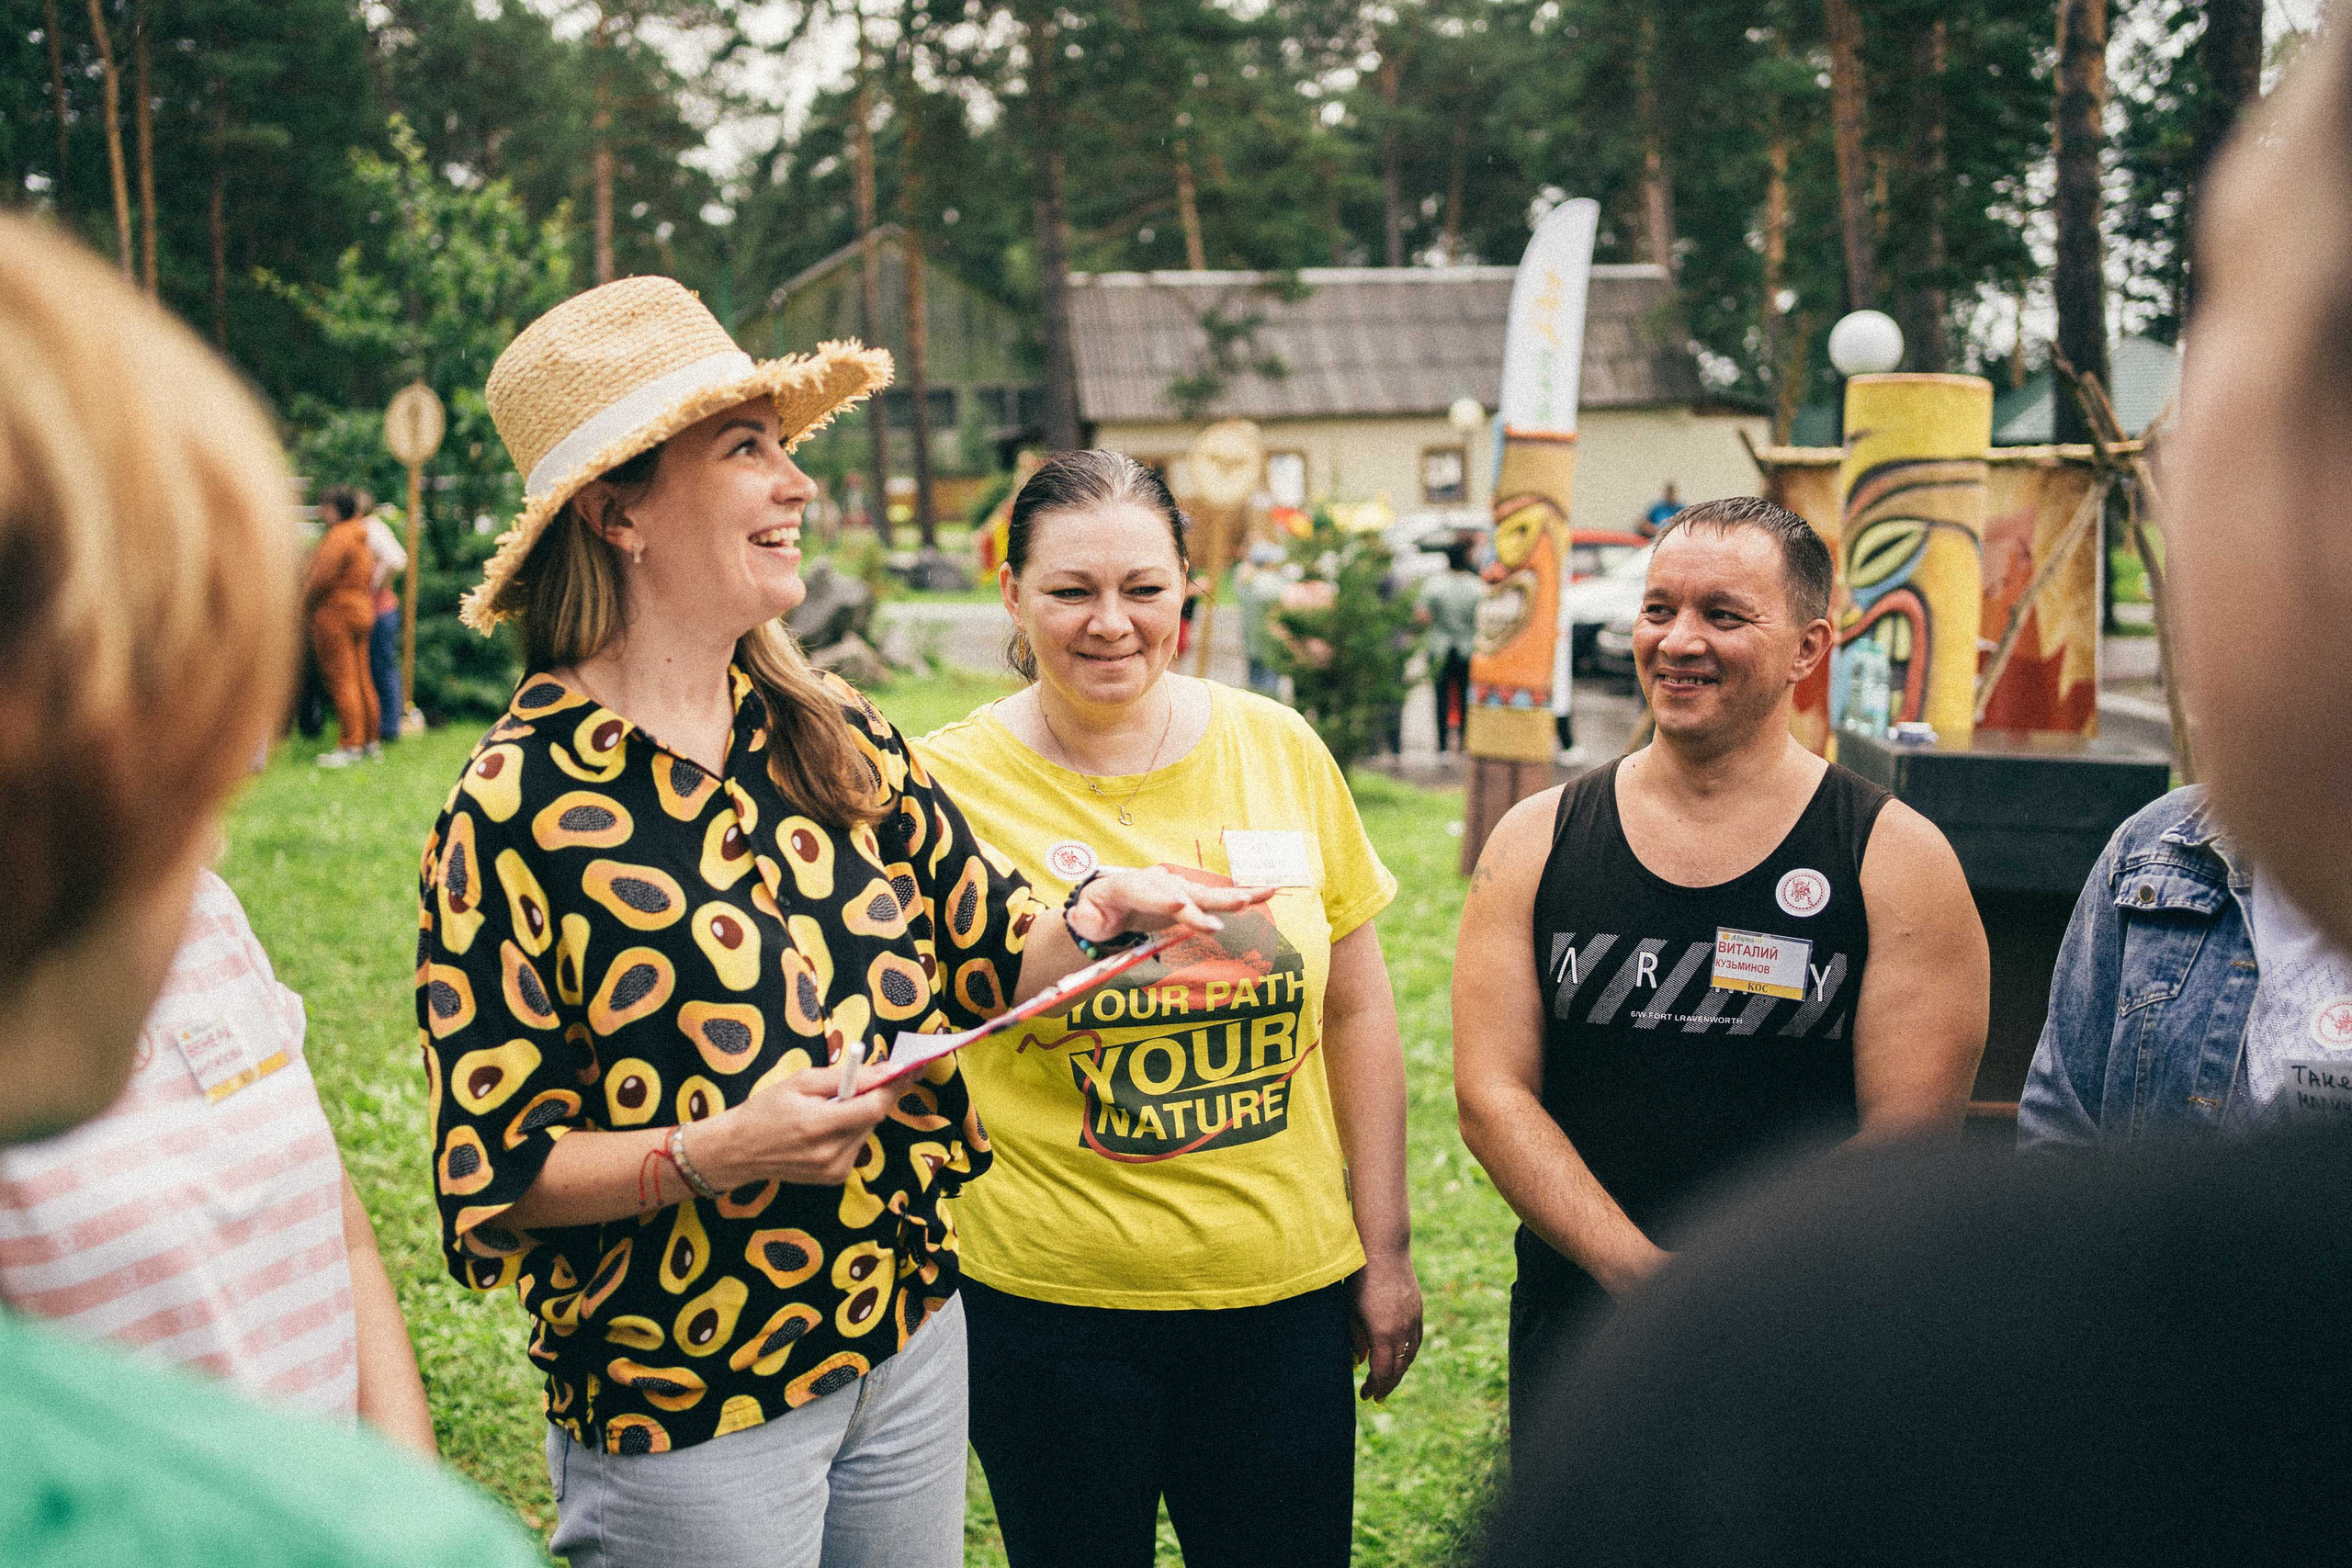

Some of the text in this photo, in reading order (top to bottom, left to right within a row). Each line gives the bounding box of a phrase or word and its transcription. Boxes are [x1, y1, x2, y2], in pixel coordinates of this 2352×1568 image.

[1714, 958, 1770, 975] КУЗЬМИНОВ
[1717, 941, 1779, 961] ВИТАЛИЙ
[1072, 967, 1305, 1024] YOUR PATH
[1648, 1011, 1673, 1021] FORT
[1070, 1011, 1295, 1104] YOUR
[1095, 1081, 1286, 1140] NATURE
